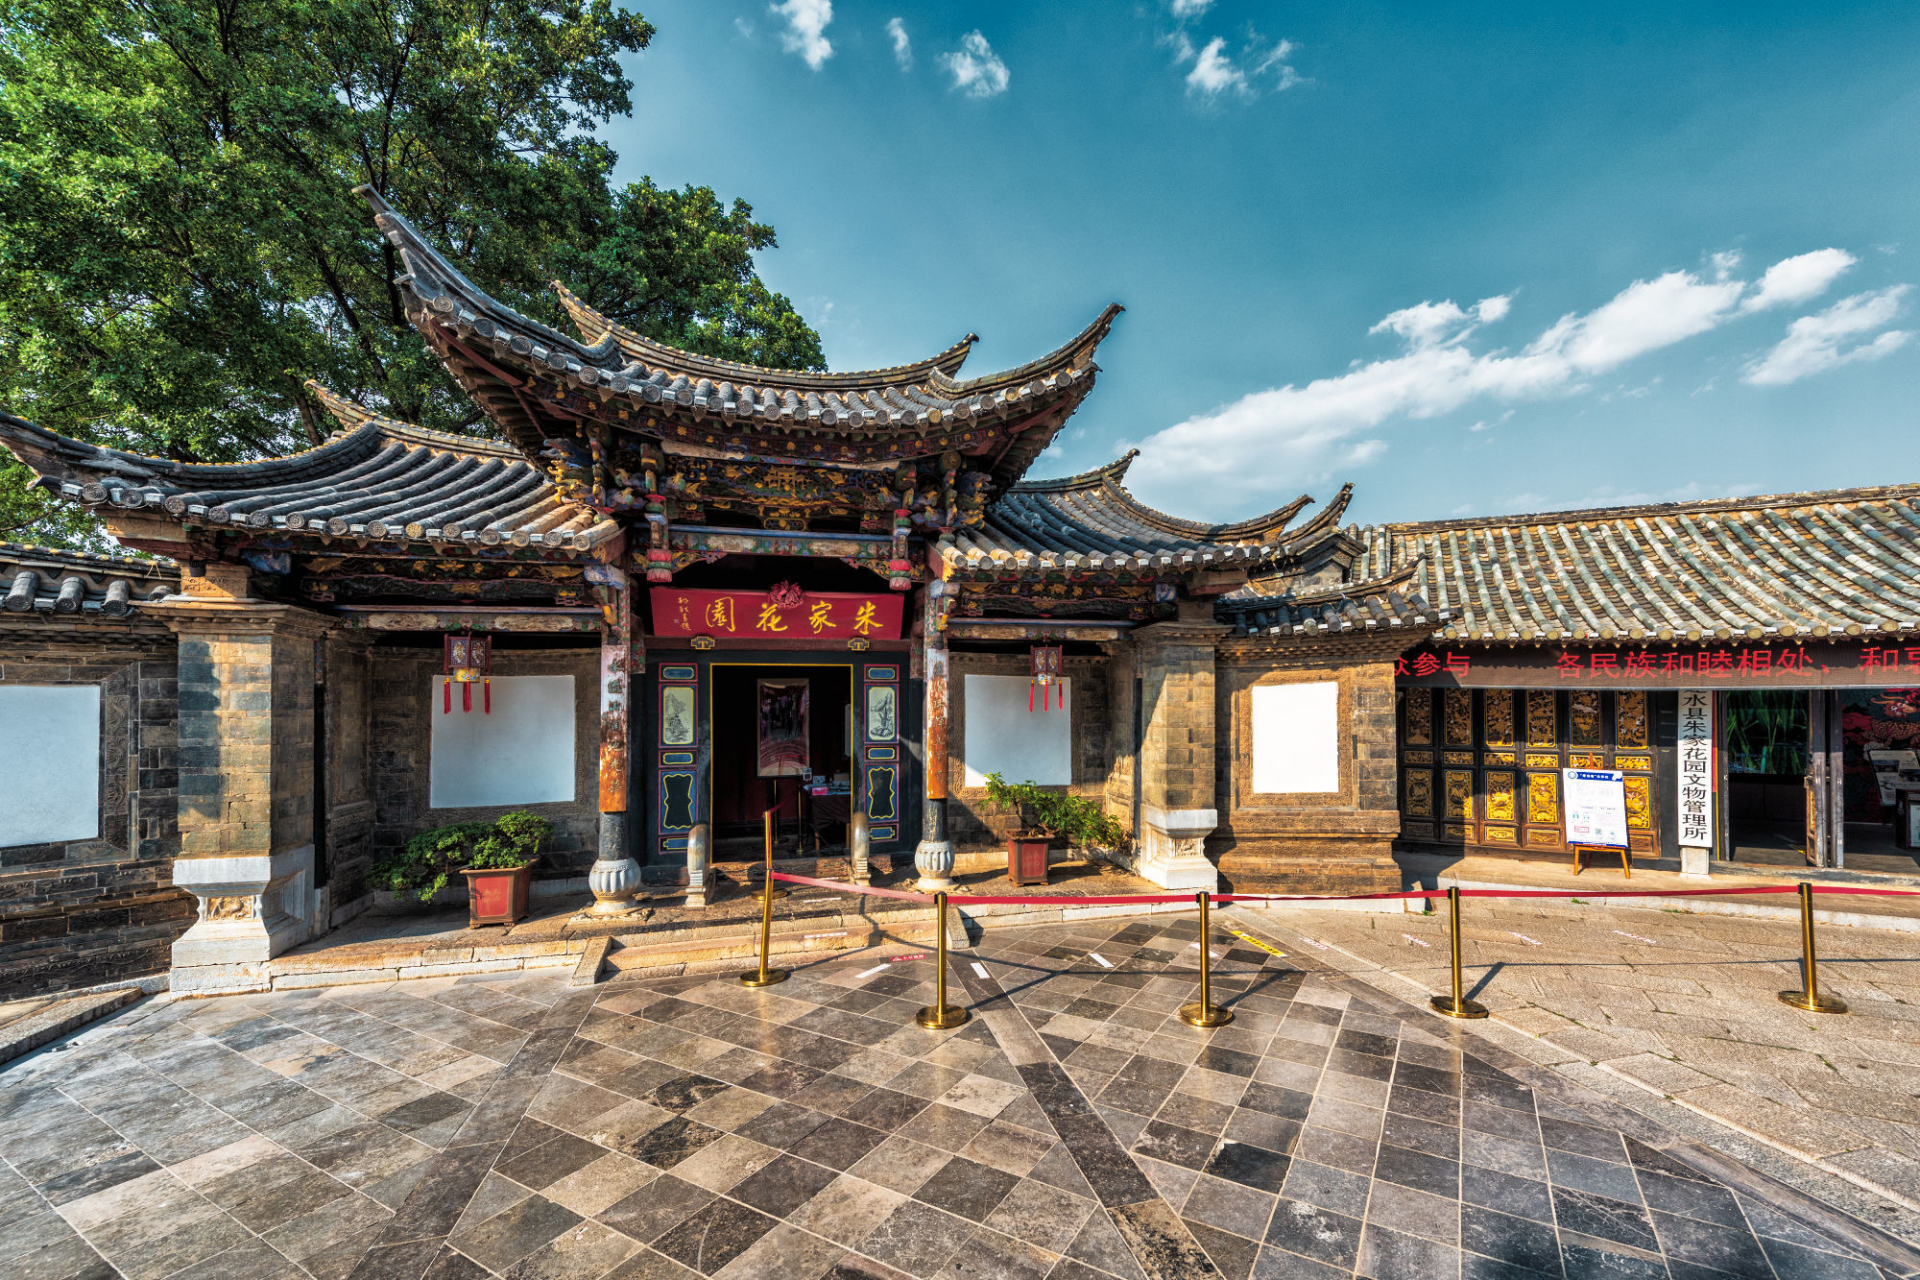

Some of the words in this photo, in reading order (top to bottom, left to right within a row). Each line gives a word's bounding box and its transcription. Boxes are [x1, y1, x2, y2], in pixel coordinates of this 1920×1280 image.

[706, 597, 883, 635] 朱家花園
[1555, 649, 1830, 678] 各民族和睦相处、
[1682, 690, 1708, 840] 水县朱家花园文物管理所
